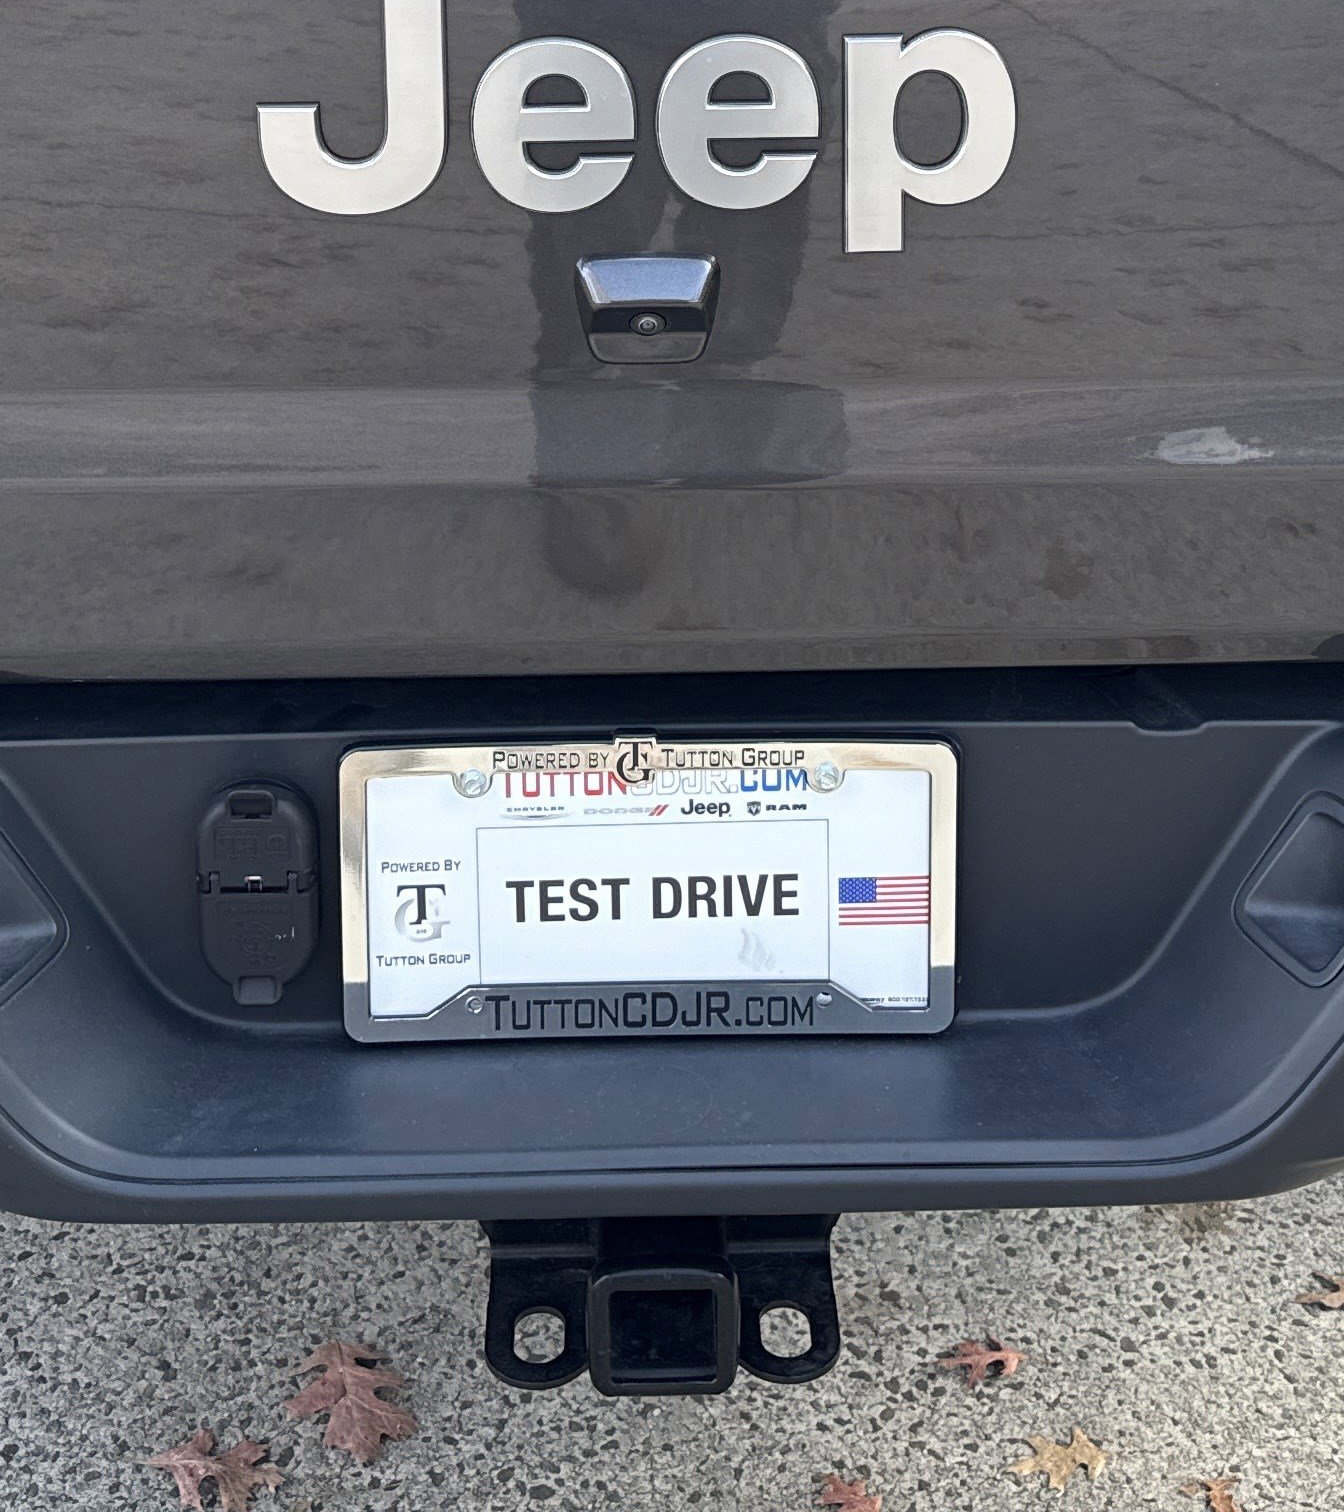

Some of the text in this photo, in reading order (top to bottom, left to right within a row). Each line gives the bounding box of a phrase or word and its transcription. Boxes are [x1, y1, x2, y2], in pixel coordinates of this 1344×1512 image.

[492, 750, 581, 770] POWERED
[588, 751, 610, 769] BY
[660, 748, 734, 768] TUTTON
[741, 747, 805, 767] GROUP
[680, 798, 731, 818] Jeep
[765, 803, 808, 811] RAM
[505, 872, 800, 923] TEST DRIVE
